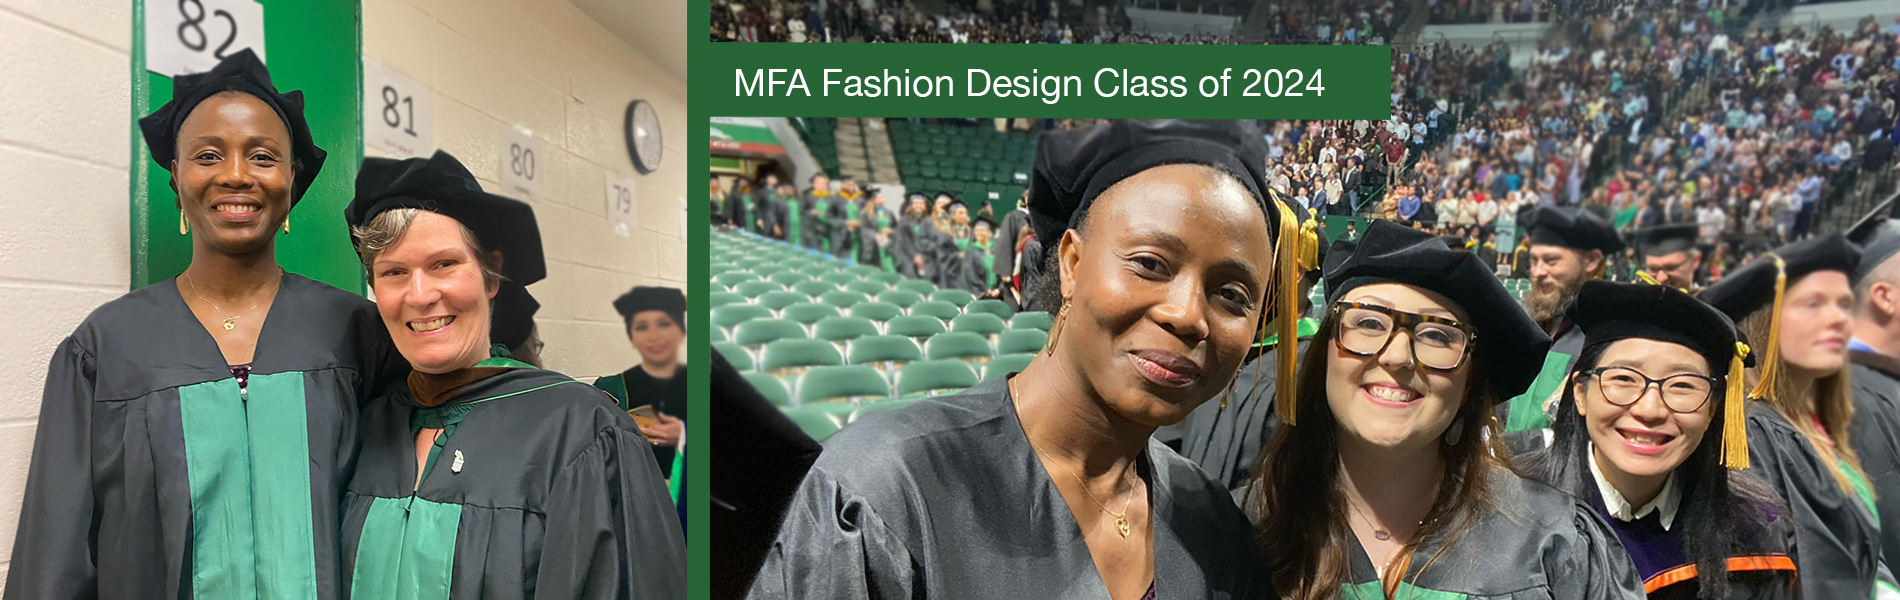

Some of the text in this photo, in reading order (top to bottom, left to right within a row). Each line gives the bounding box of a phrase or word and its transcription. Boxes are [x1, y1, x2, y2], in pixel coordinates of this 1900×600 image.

[177, 0, 237, 61] 82
[382, 85, 417, 137] 81
[510, 143, 535, 181] 80
[613, 184, 632, 213] 79
